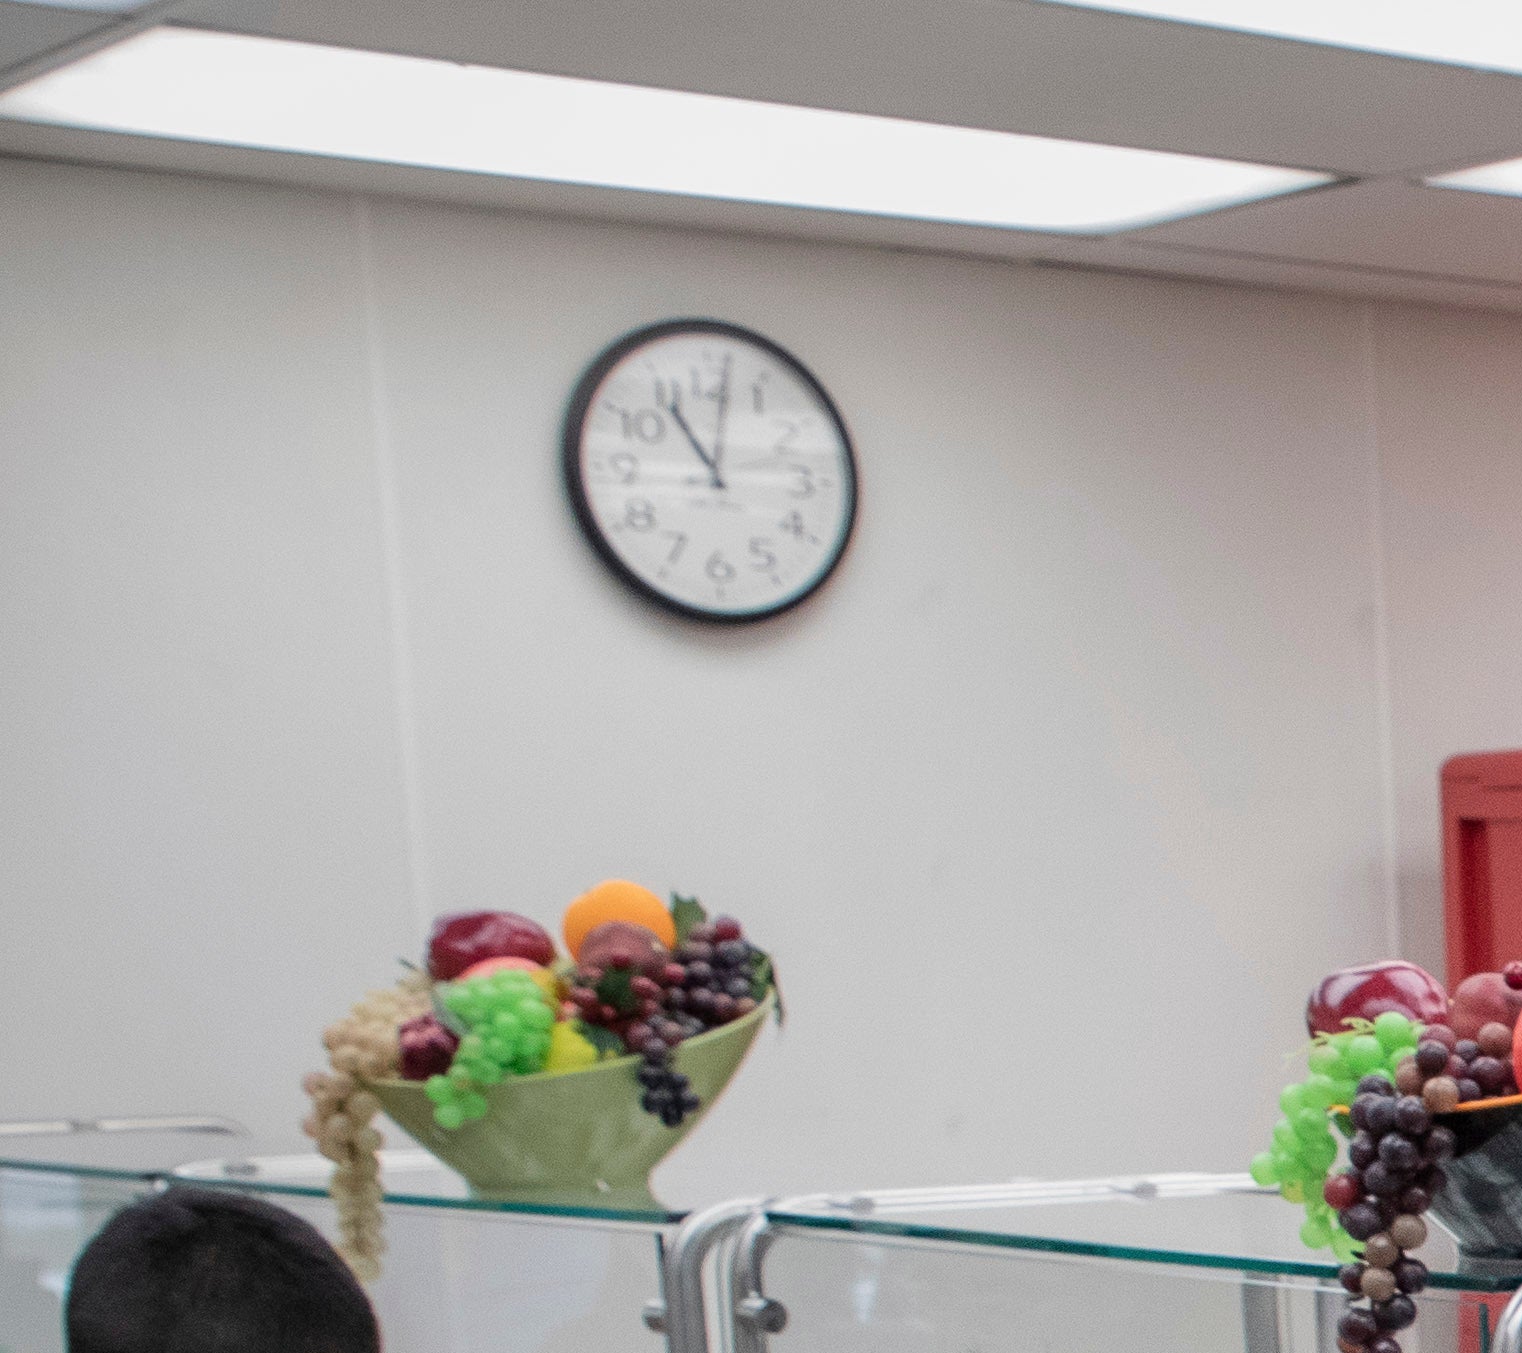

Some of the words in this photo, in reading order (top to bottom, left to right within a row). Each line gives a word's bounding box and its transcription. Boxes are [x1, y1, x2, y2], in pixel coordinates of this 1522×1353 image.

[619, 407, 666, 445] 10
[610, 452, 638, 486] 9
[789, 465, 816, 500] 3
[625, 500, 657, 533] 8
[777, 511, 806, 541] 4
[661, 530, 688, 565] 7
[750, 537, 777, 572] 5
[704, 551, 736, 584] 6
